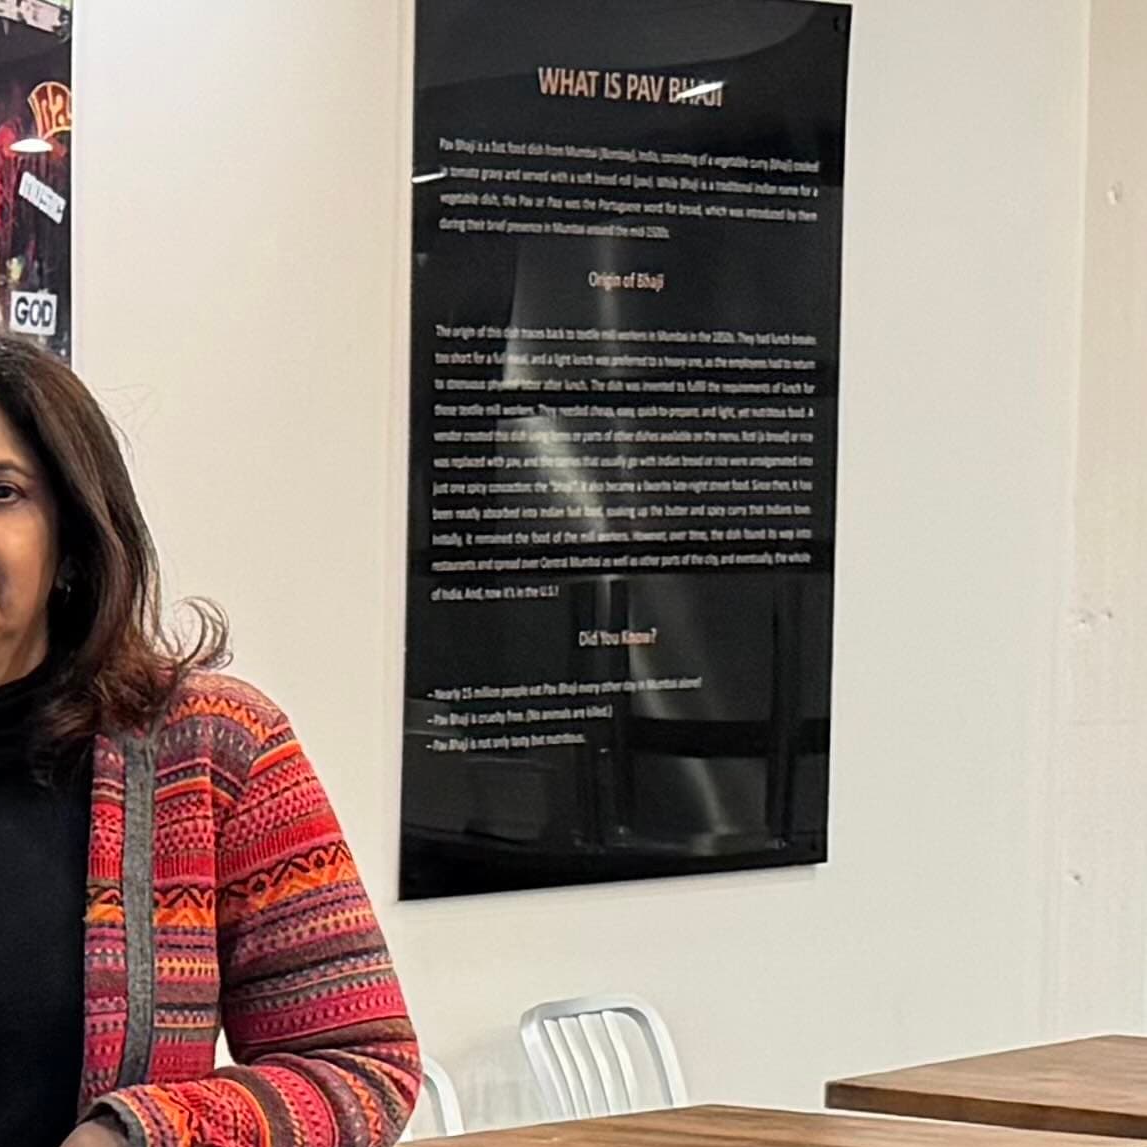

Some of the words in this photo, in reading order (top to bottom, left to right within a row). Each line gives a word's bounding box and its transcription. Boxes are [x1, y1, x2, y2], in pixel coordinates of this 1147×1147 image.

[538, 67, 599, 97] WHAT
[604, 72, 622, 99] IS
[626, 74, 665, 103] PAV
[588, 271, 621, 291] Origin
[622, 272, 635, 288] of
[636, 273, 664, 292] Bhaji
[14, 296, 54, 328] GOD
[579, 631, 598, 646] Did
